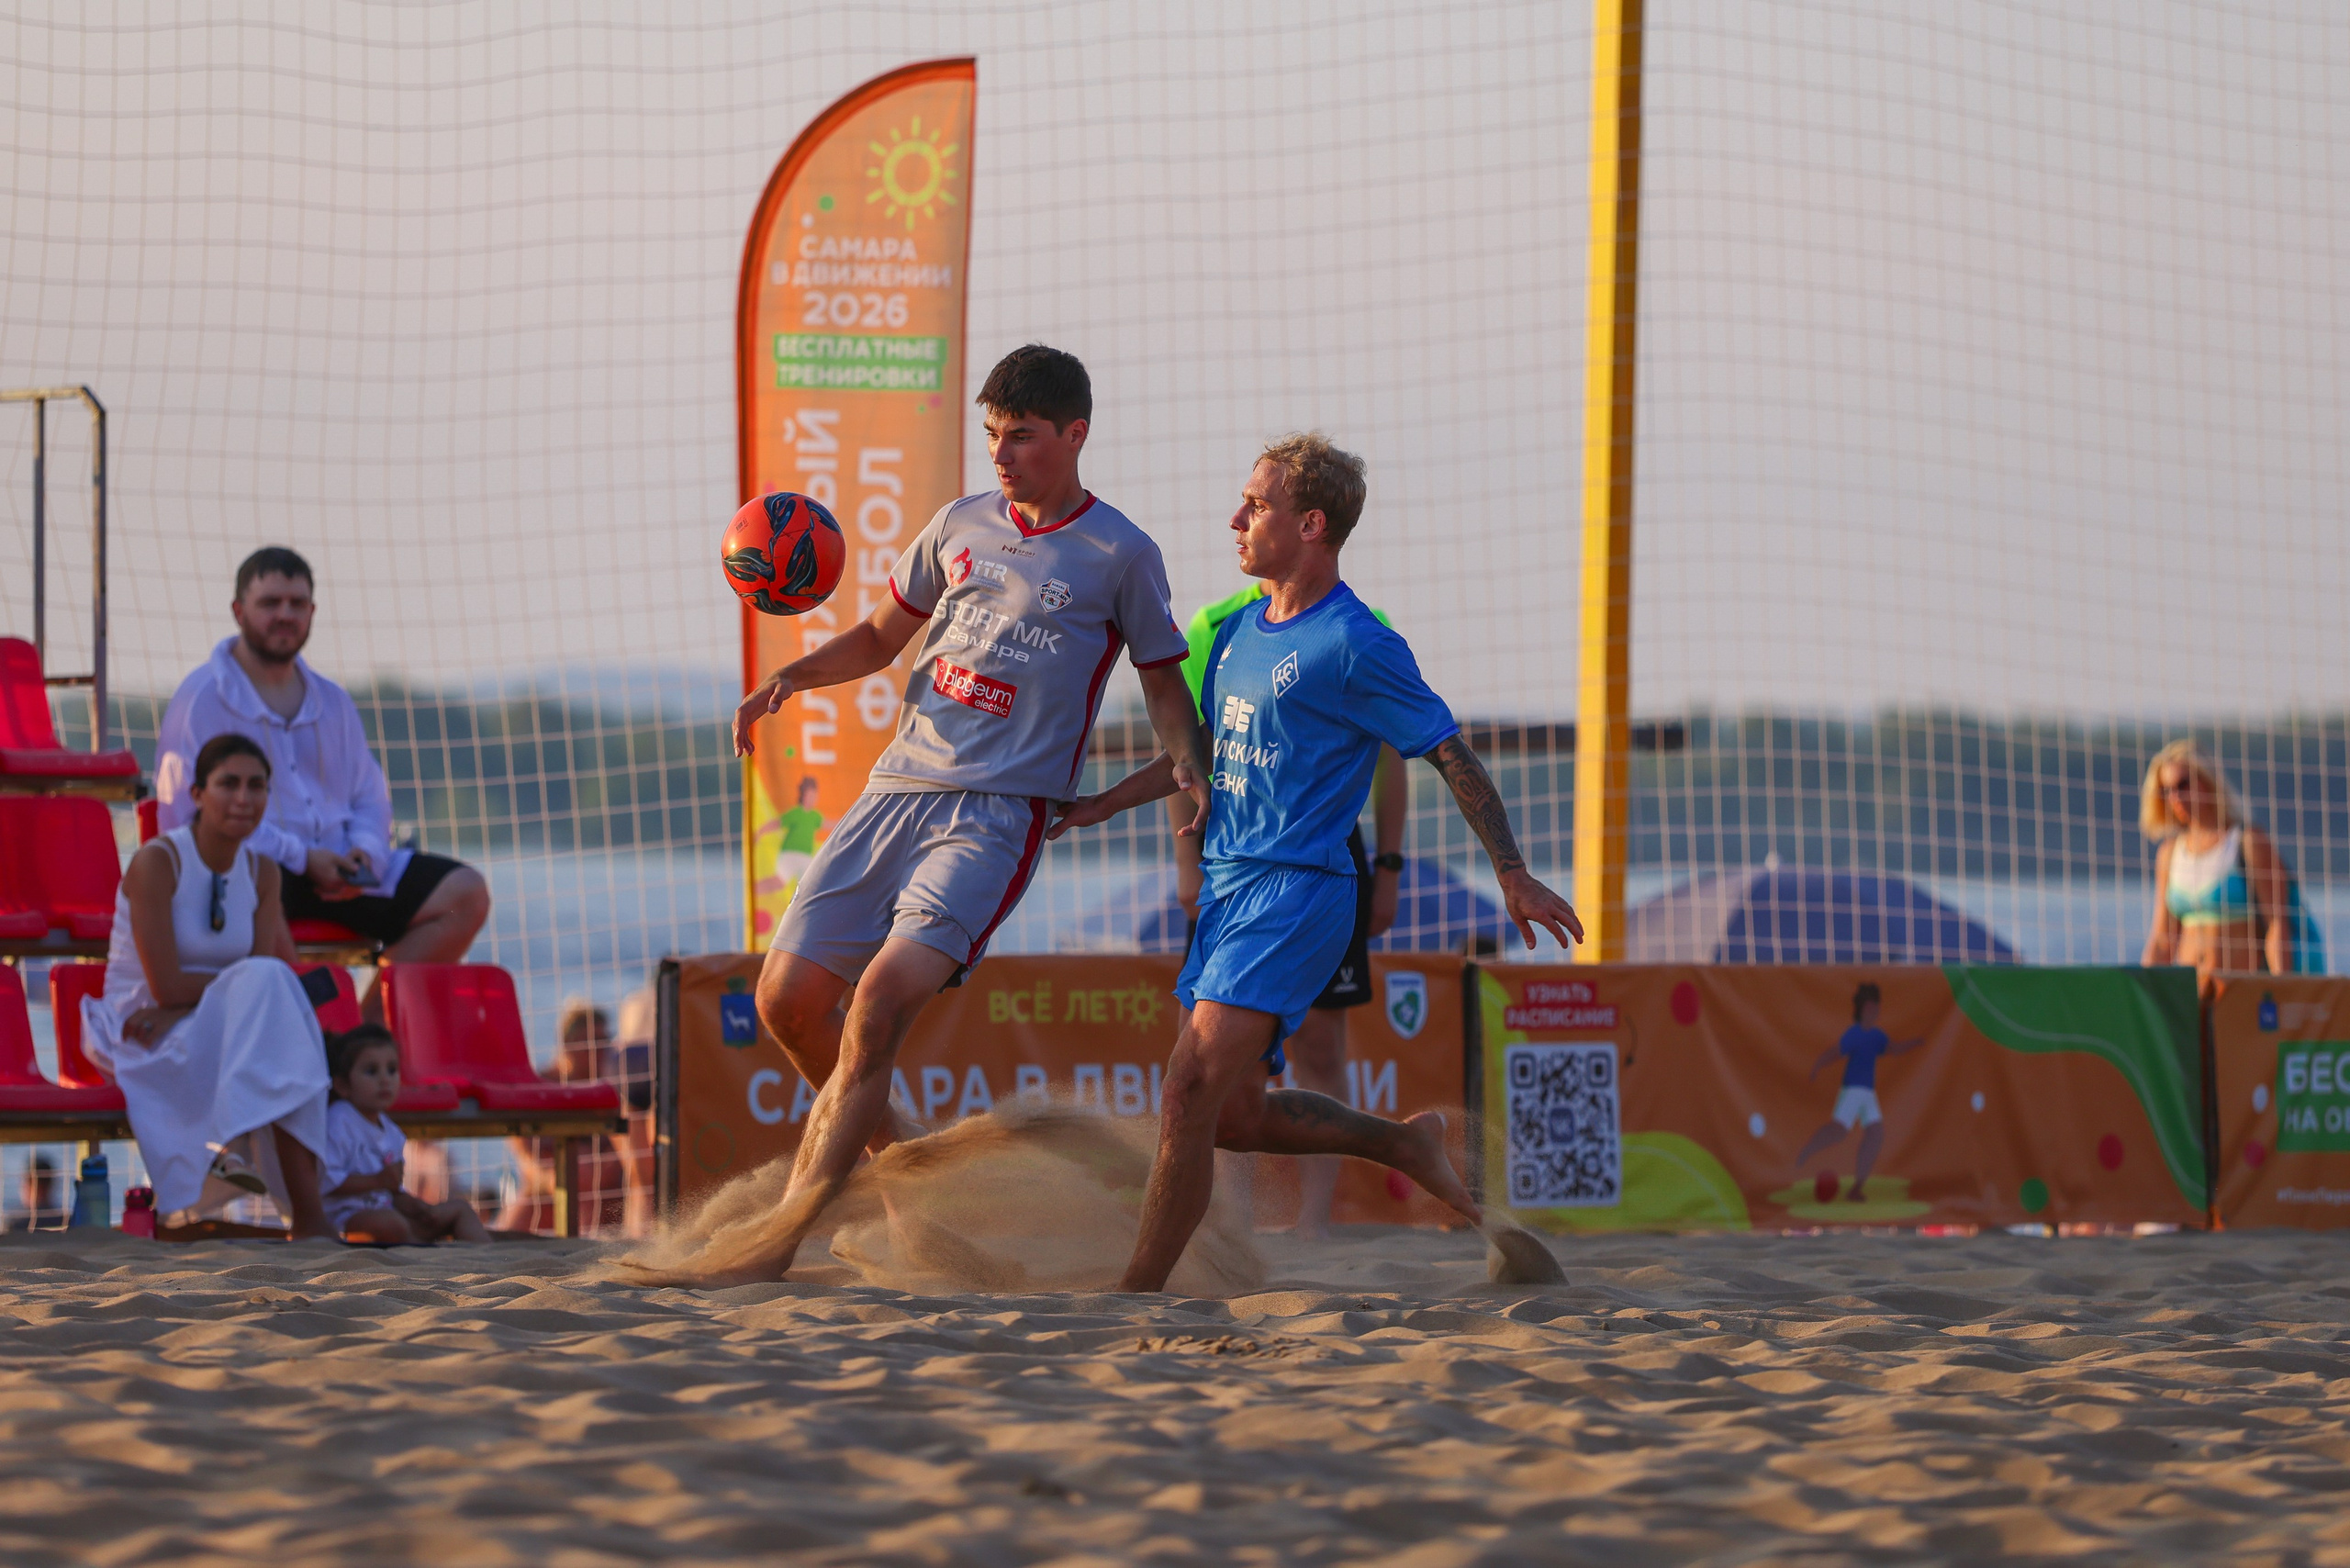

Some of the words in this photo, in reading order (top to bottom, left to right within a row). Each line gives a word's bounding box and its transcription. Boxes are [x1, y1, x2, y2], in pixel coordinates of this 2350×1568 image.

[799, 234, 917, 262] САМАРА
[791, 260, 953, 290] ДВИЖЕНИИ
[801, 290, 910, 329] 2026
[778, 335, 939, 362] БЕСПЛАТНЫЕ
[778, 364, 937, 388] ТРЕНИРОВКИ
[855, 446, 904, 731] ФТБОЛ
[933, 598, 1010, 634] SPORT
[947, 625, 1030, 663] Самара
[945, 669, 1013, 705] alageum
[974, 699, 1008, 716] electric
[989, 980, 1053, 1024] ВСЁ
[1527, 982, 1593, 1003] УЗНАТЬ
